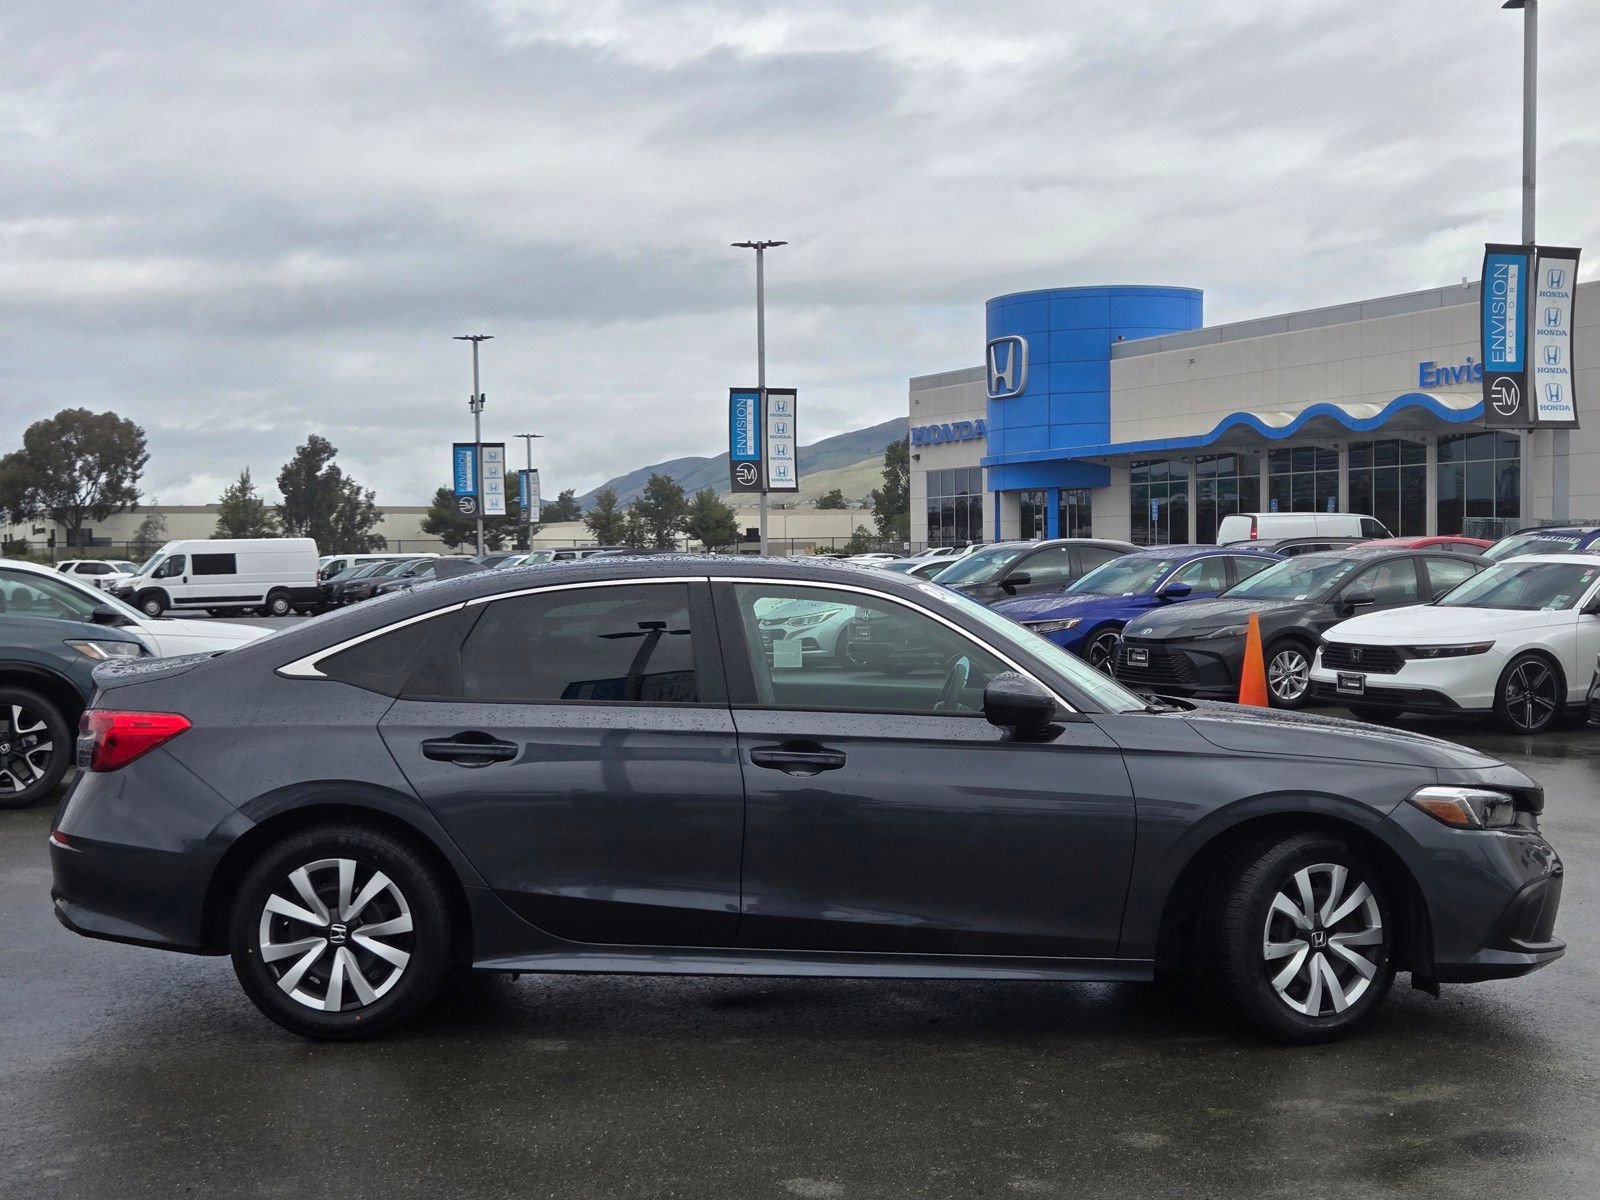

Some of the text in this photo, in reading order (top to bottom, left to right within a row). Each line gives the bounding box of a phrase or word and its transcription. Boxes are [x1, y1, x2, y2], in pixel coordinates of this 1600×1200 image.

[1539, 291, 1570, 299] HONDA
[1492, 264, 1508, 362] ENVISION
[1508, 273, 1516, 354] MOTORS
[1537, 329, 1568, 337] HONDA
[1537, 366, 1568, 374] HONDA
[1539, 404, 1571, 412] HONDA
[737, 398, 747, 455] ENVISION
[911, 419, 987, 446] HONDA
[458, 450, 467, 492] ENVISION
